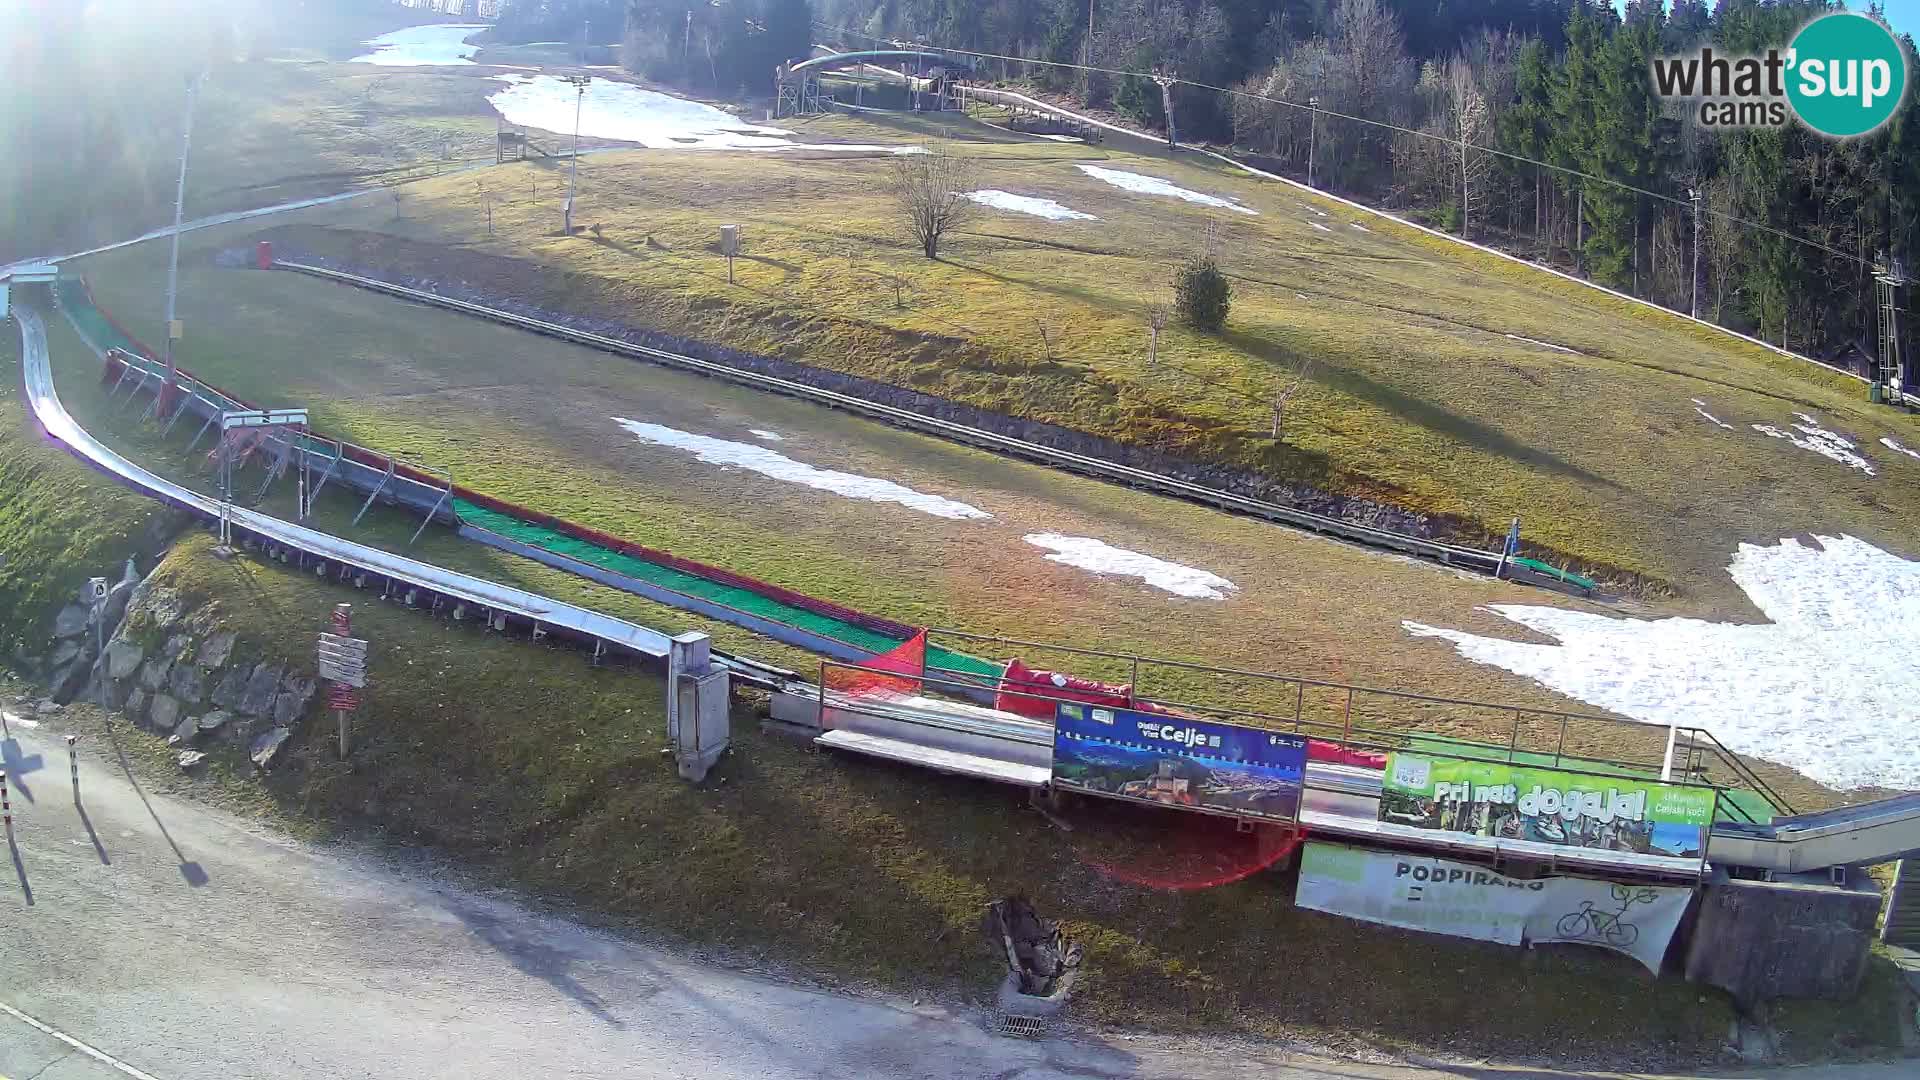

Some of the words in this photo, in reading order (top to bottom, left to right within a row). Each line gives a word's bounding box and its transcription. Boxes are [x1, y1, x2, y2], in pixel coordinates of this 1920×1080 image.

[1160, 725, 1207, 748] Celje
[1433, 780, 1470, 803] Pri
[1475, 783, 1517, 804] nas
[1518, 785, 1646, 824] dogaja!
